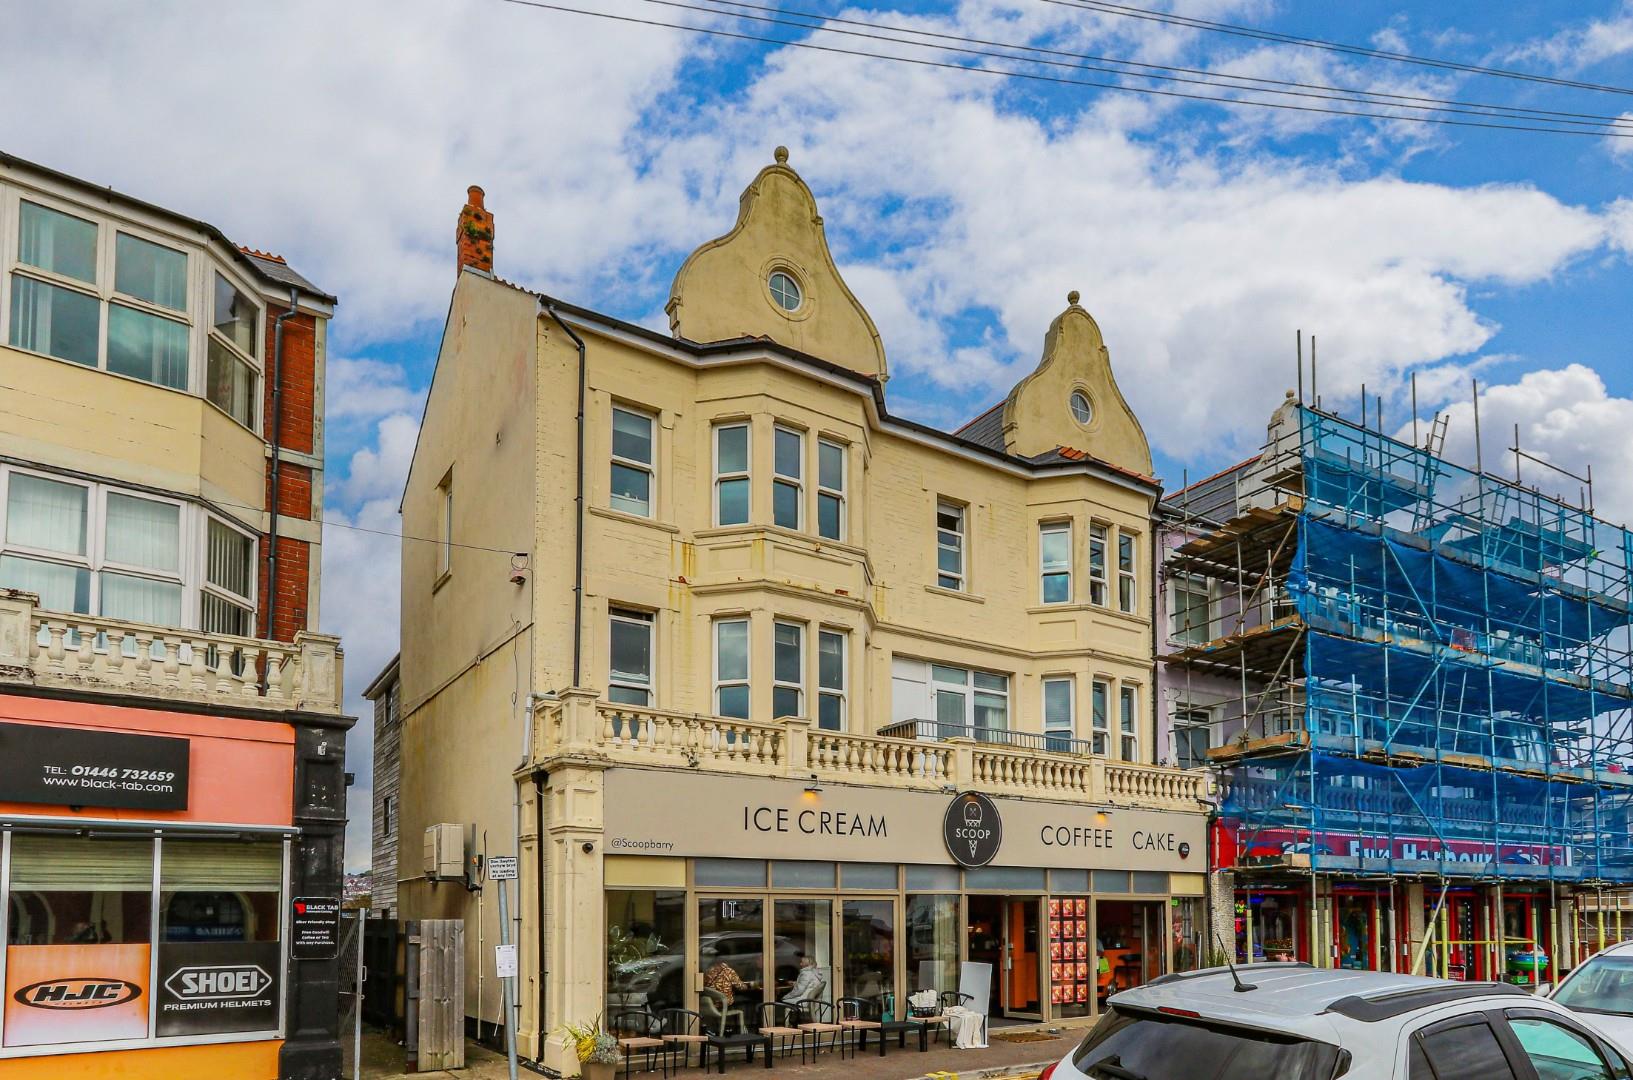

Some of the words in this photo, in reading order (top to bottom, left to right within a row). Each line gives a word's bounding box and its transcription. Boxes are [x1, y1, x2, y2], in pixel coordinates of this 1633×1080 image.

[43, 765, 67, 775] TEL:
[71, 765, 118, 778] 01446
[120, 769, 175, 782] 732659
[744, 806, 789, 833] ICE
[798, 809, 888, 838] CREAM
[955, 827, 991, 840] SCOOP
[1040, 825, 1113, 849] COFFEE
[1132, 830, 1175, 851] CAKE
[610, 837, 674, 851] @Scoopbarry
[181, 971, 258, 995] SHOEI
[32, 983, 123, 1002] HJC
[163, 1002, 218, 1011] PREMIUM
[220, 1000, 272, 1009] HELMETS
